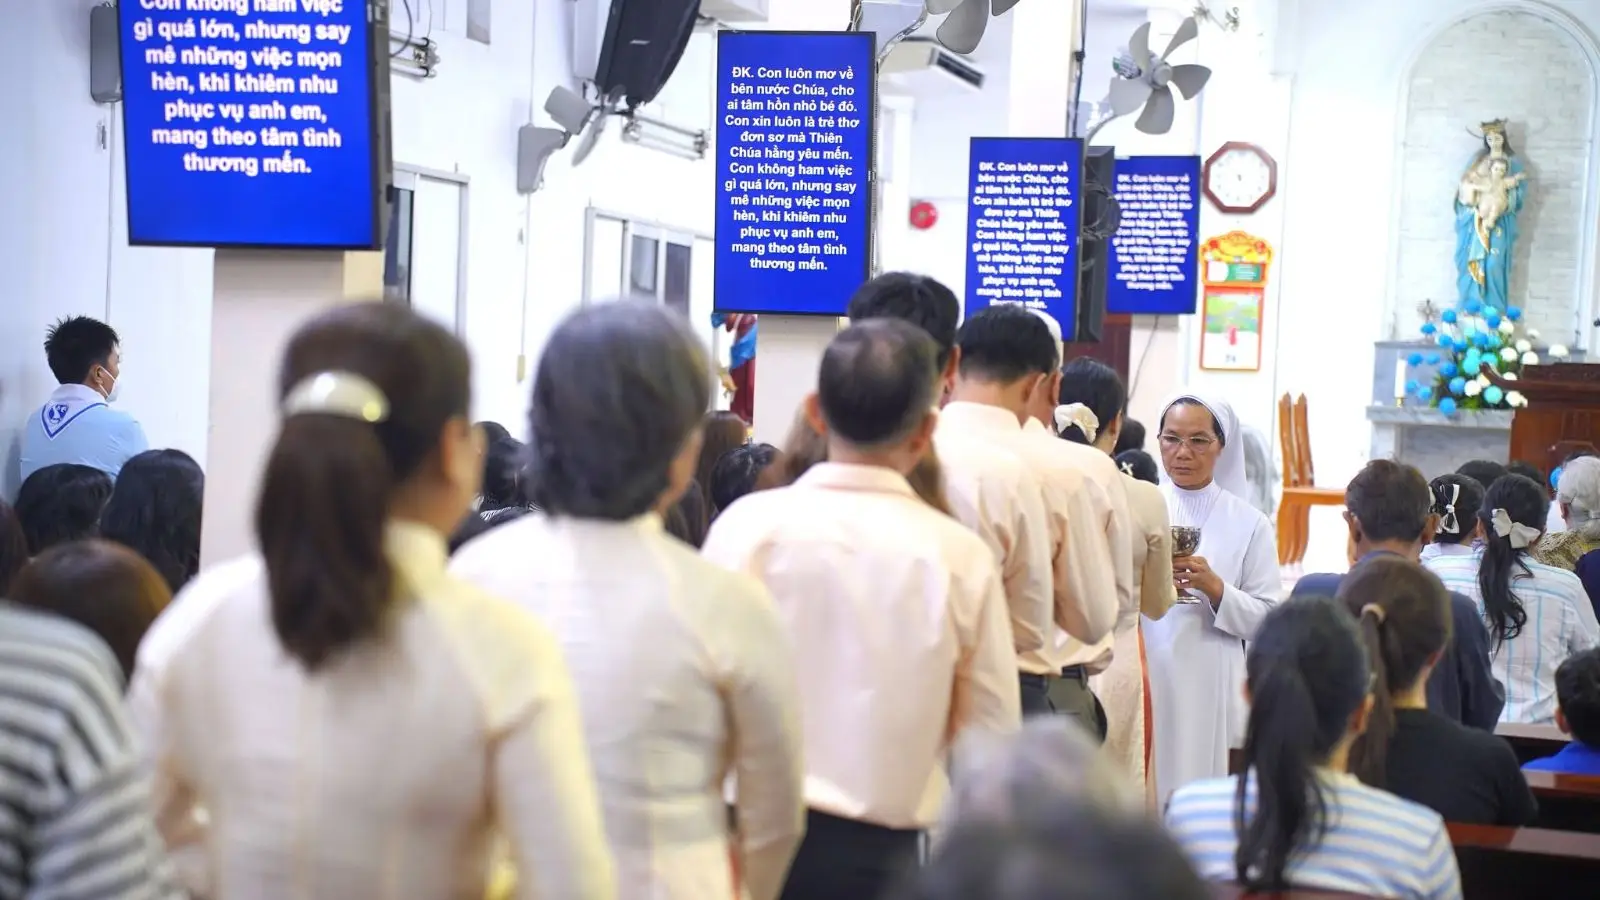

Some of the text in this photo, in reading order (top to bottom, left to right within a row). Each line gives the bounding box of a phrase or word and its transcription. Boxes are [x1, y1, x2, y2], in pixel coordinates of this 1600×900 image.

[134, 18, 351, 45] gì quá lớn, nhưng say
[145, 45, 341, 71] mê những việc mọn
[732, 66, 854, 79] ĐK. Con luôn mơ về
[152, 71, 338, 94] hèn, khi khiêm nhu
[731, 83, 854, 97] bên nước Chúa, cho
[165, 99, 327, 123] phục vụ anh em,
[727, 97, 857, 112] ai tâm hồn nhỏ bé đó.
[725, 115, 860, 128] Con xin luôn là trẻ thơ
[152, 126, 341, 149] mang theo tâm tình
[740, 131, 842, 143] đơn sơ mà Thiên
[730, 146, 852, 161] Chúa hằng yêu mến.
[183, 150, 311, 177] thương mến.
[729, 162, 852, 178] Con không ham việc
[725, 178, 857, 194] gì quá lớn, nhưng say
[731, 194, 850, 209] mê những việc mọn
[733, 210, 847, 223] hèn, khi khiêm nhu
[740, 226, 839, 241] phục vụ anh em,
[732, 242, 847, 255] mang theo tâm tình
[750, 257, 827, 272] thương mến.
